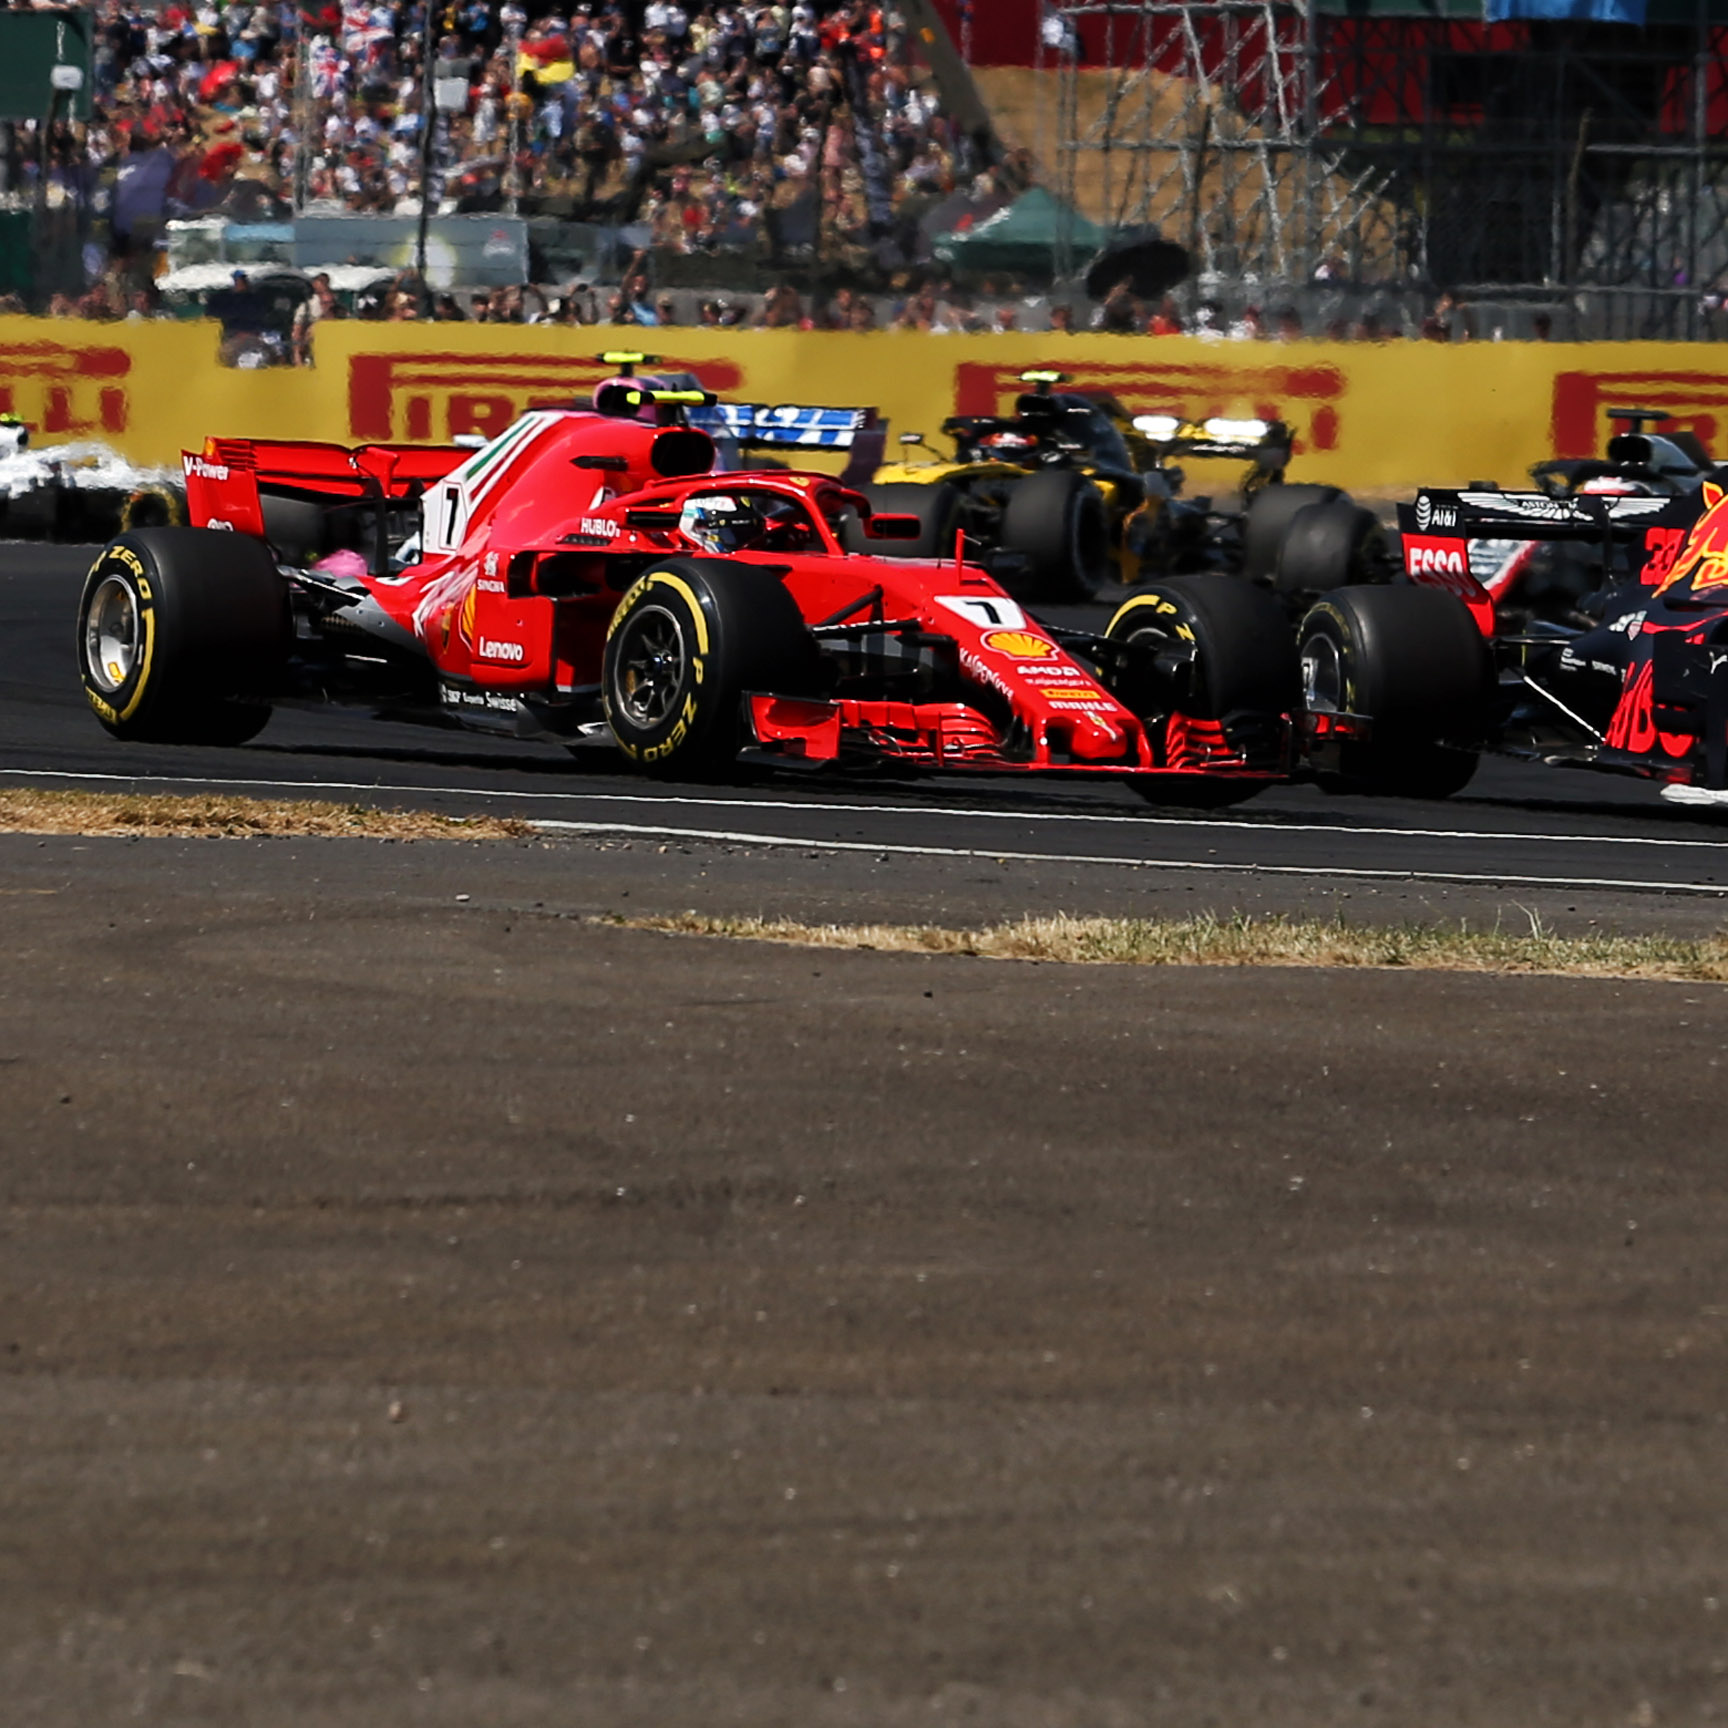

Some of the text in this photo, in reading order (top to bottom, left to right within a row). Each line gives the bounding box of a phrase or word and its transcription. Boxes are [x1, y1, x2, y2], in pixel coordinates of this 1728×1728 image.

[183, 455, 230, 481] V-Power
[108, 545, 153, 600] ZERO
[479, 637, 524, 662] Lenovo
